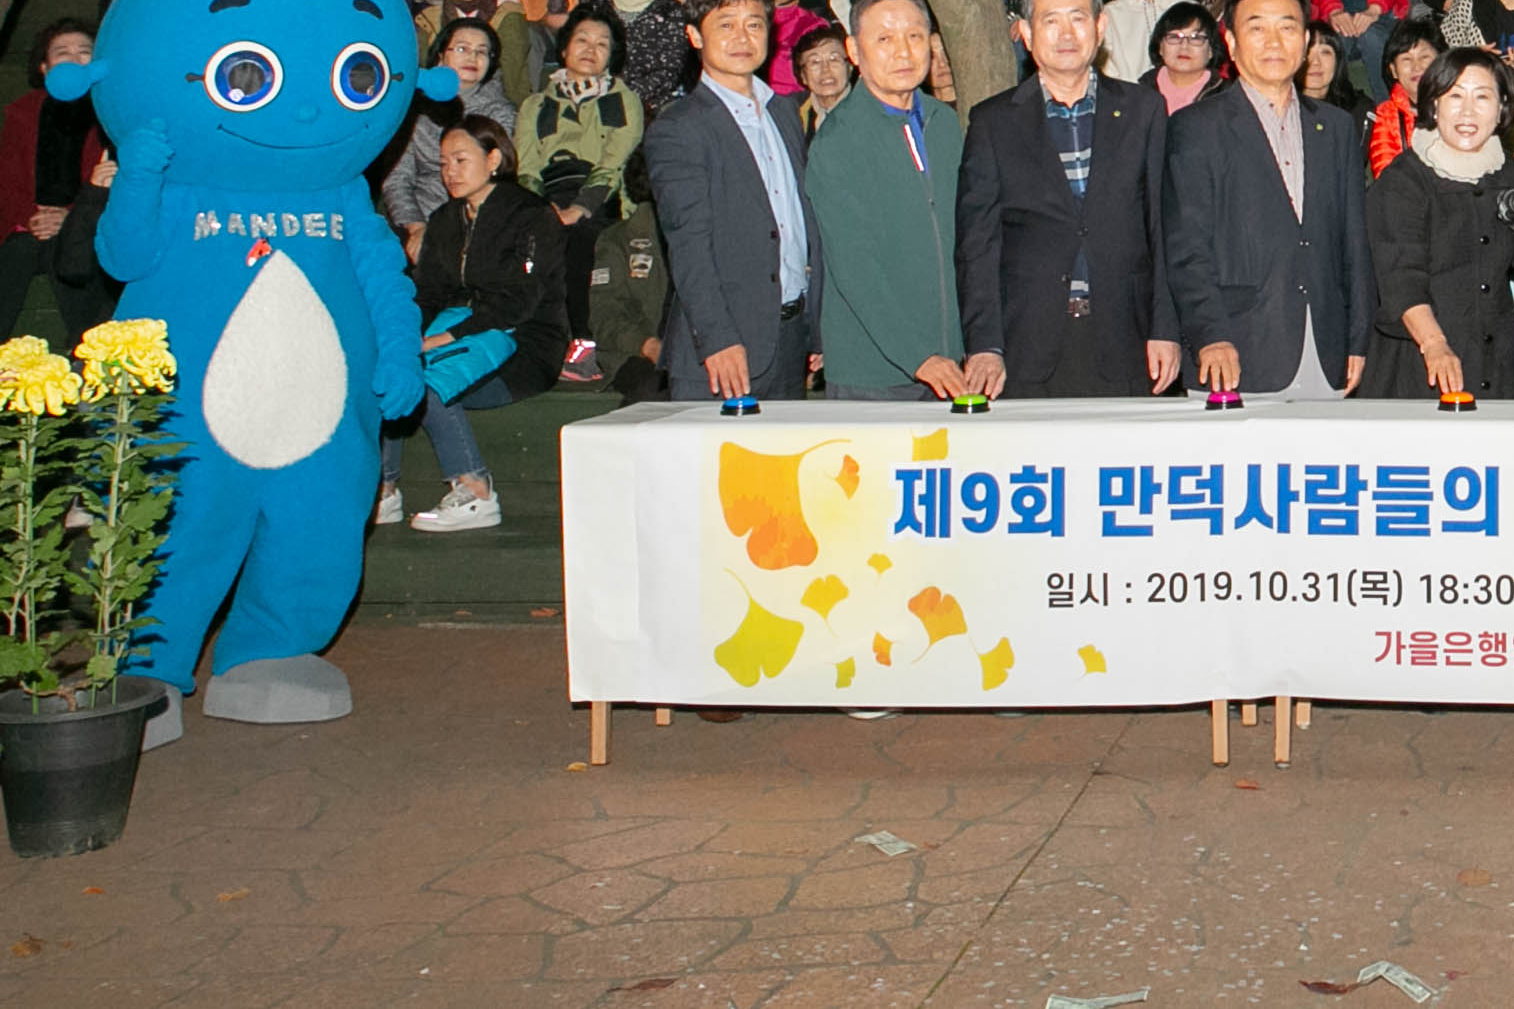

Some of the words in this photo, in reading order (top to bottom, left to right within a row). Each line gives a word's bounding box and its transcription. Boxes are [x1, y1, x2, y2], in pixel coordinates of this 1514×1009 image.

[193, 210, 344, 241] MANDEE
[893, 464, 1066, 539] 제9회
[1098, 463, 1500, 537] 만덕사람들의
[1046, 572, 1109, 608] 일시
[1146, 569, 1404, 607] 2019.10.31(목)
